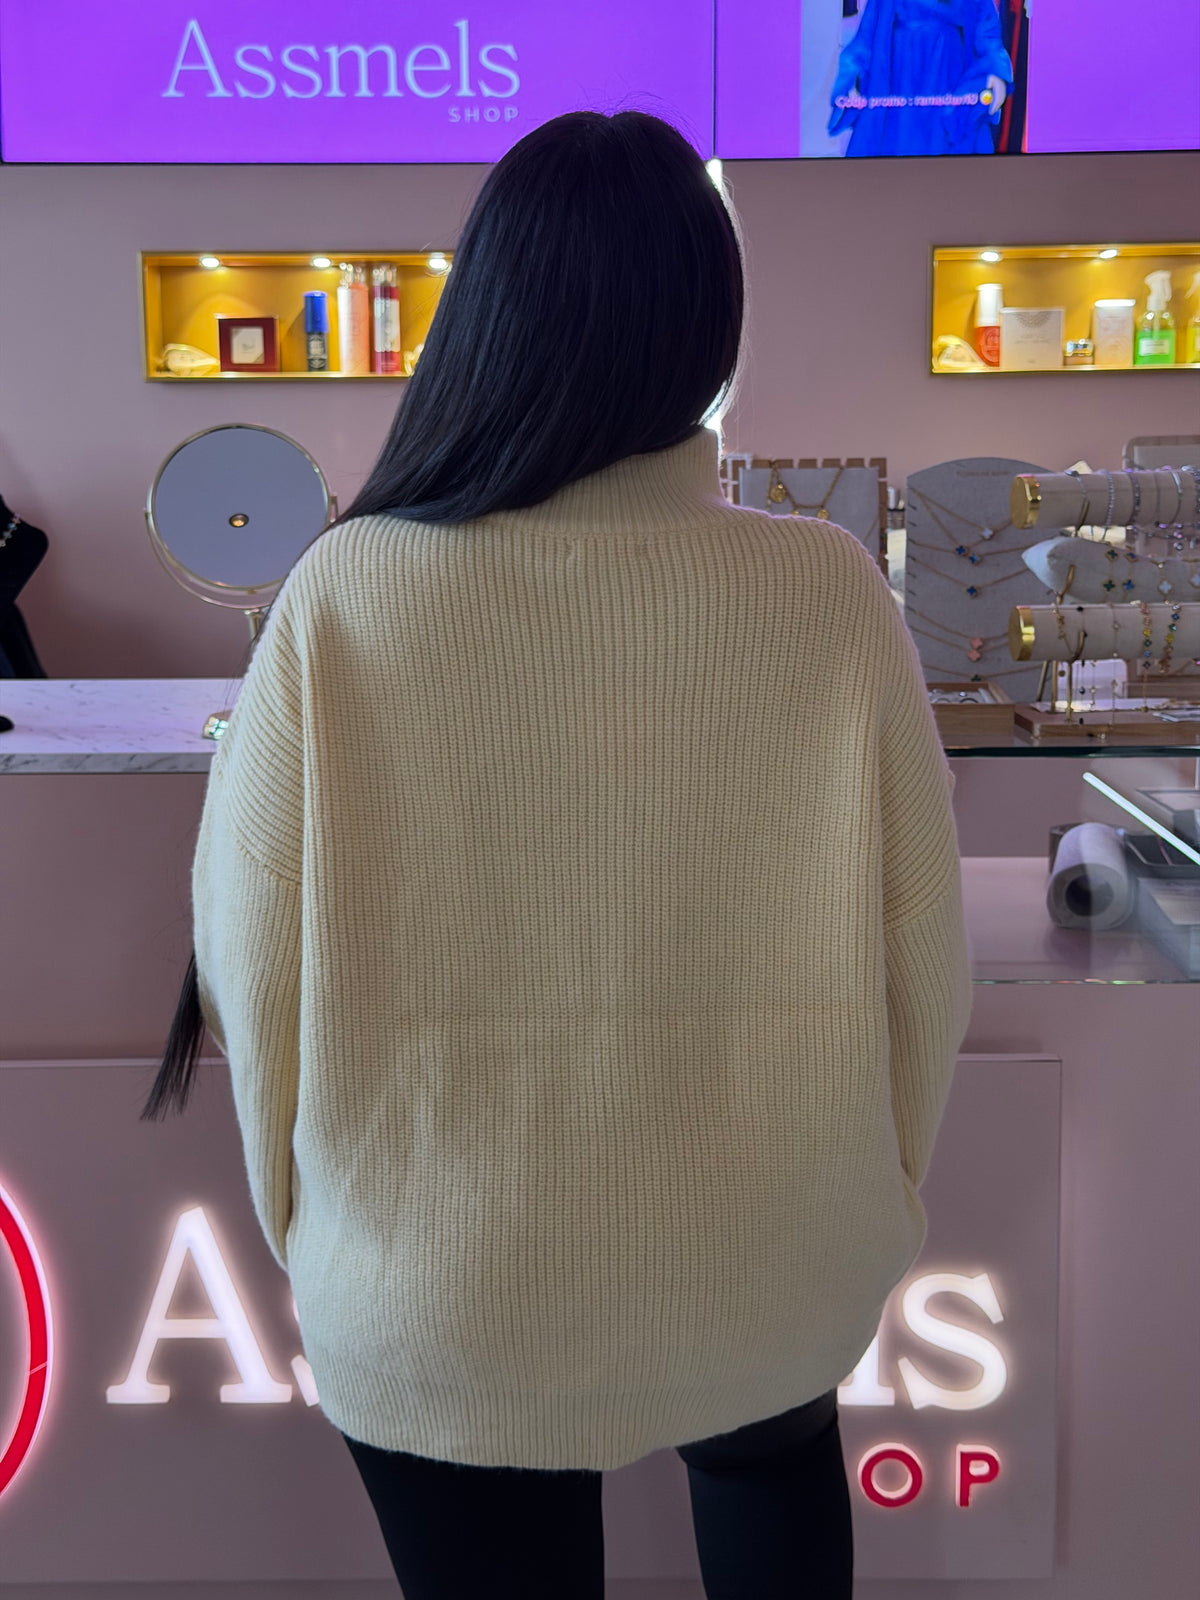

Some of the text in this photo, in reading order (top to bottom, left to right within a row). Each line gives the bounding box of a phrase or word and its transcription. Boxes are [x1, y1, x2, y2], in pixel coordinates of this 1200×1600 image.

[161, 19, 520, 99] Assmels
[869, 96, 907, 109] promo
[448, 107, 519, 123] SHOP
